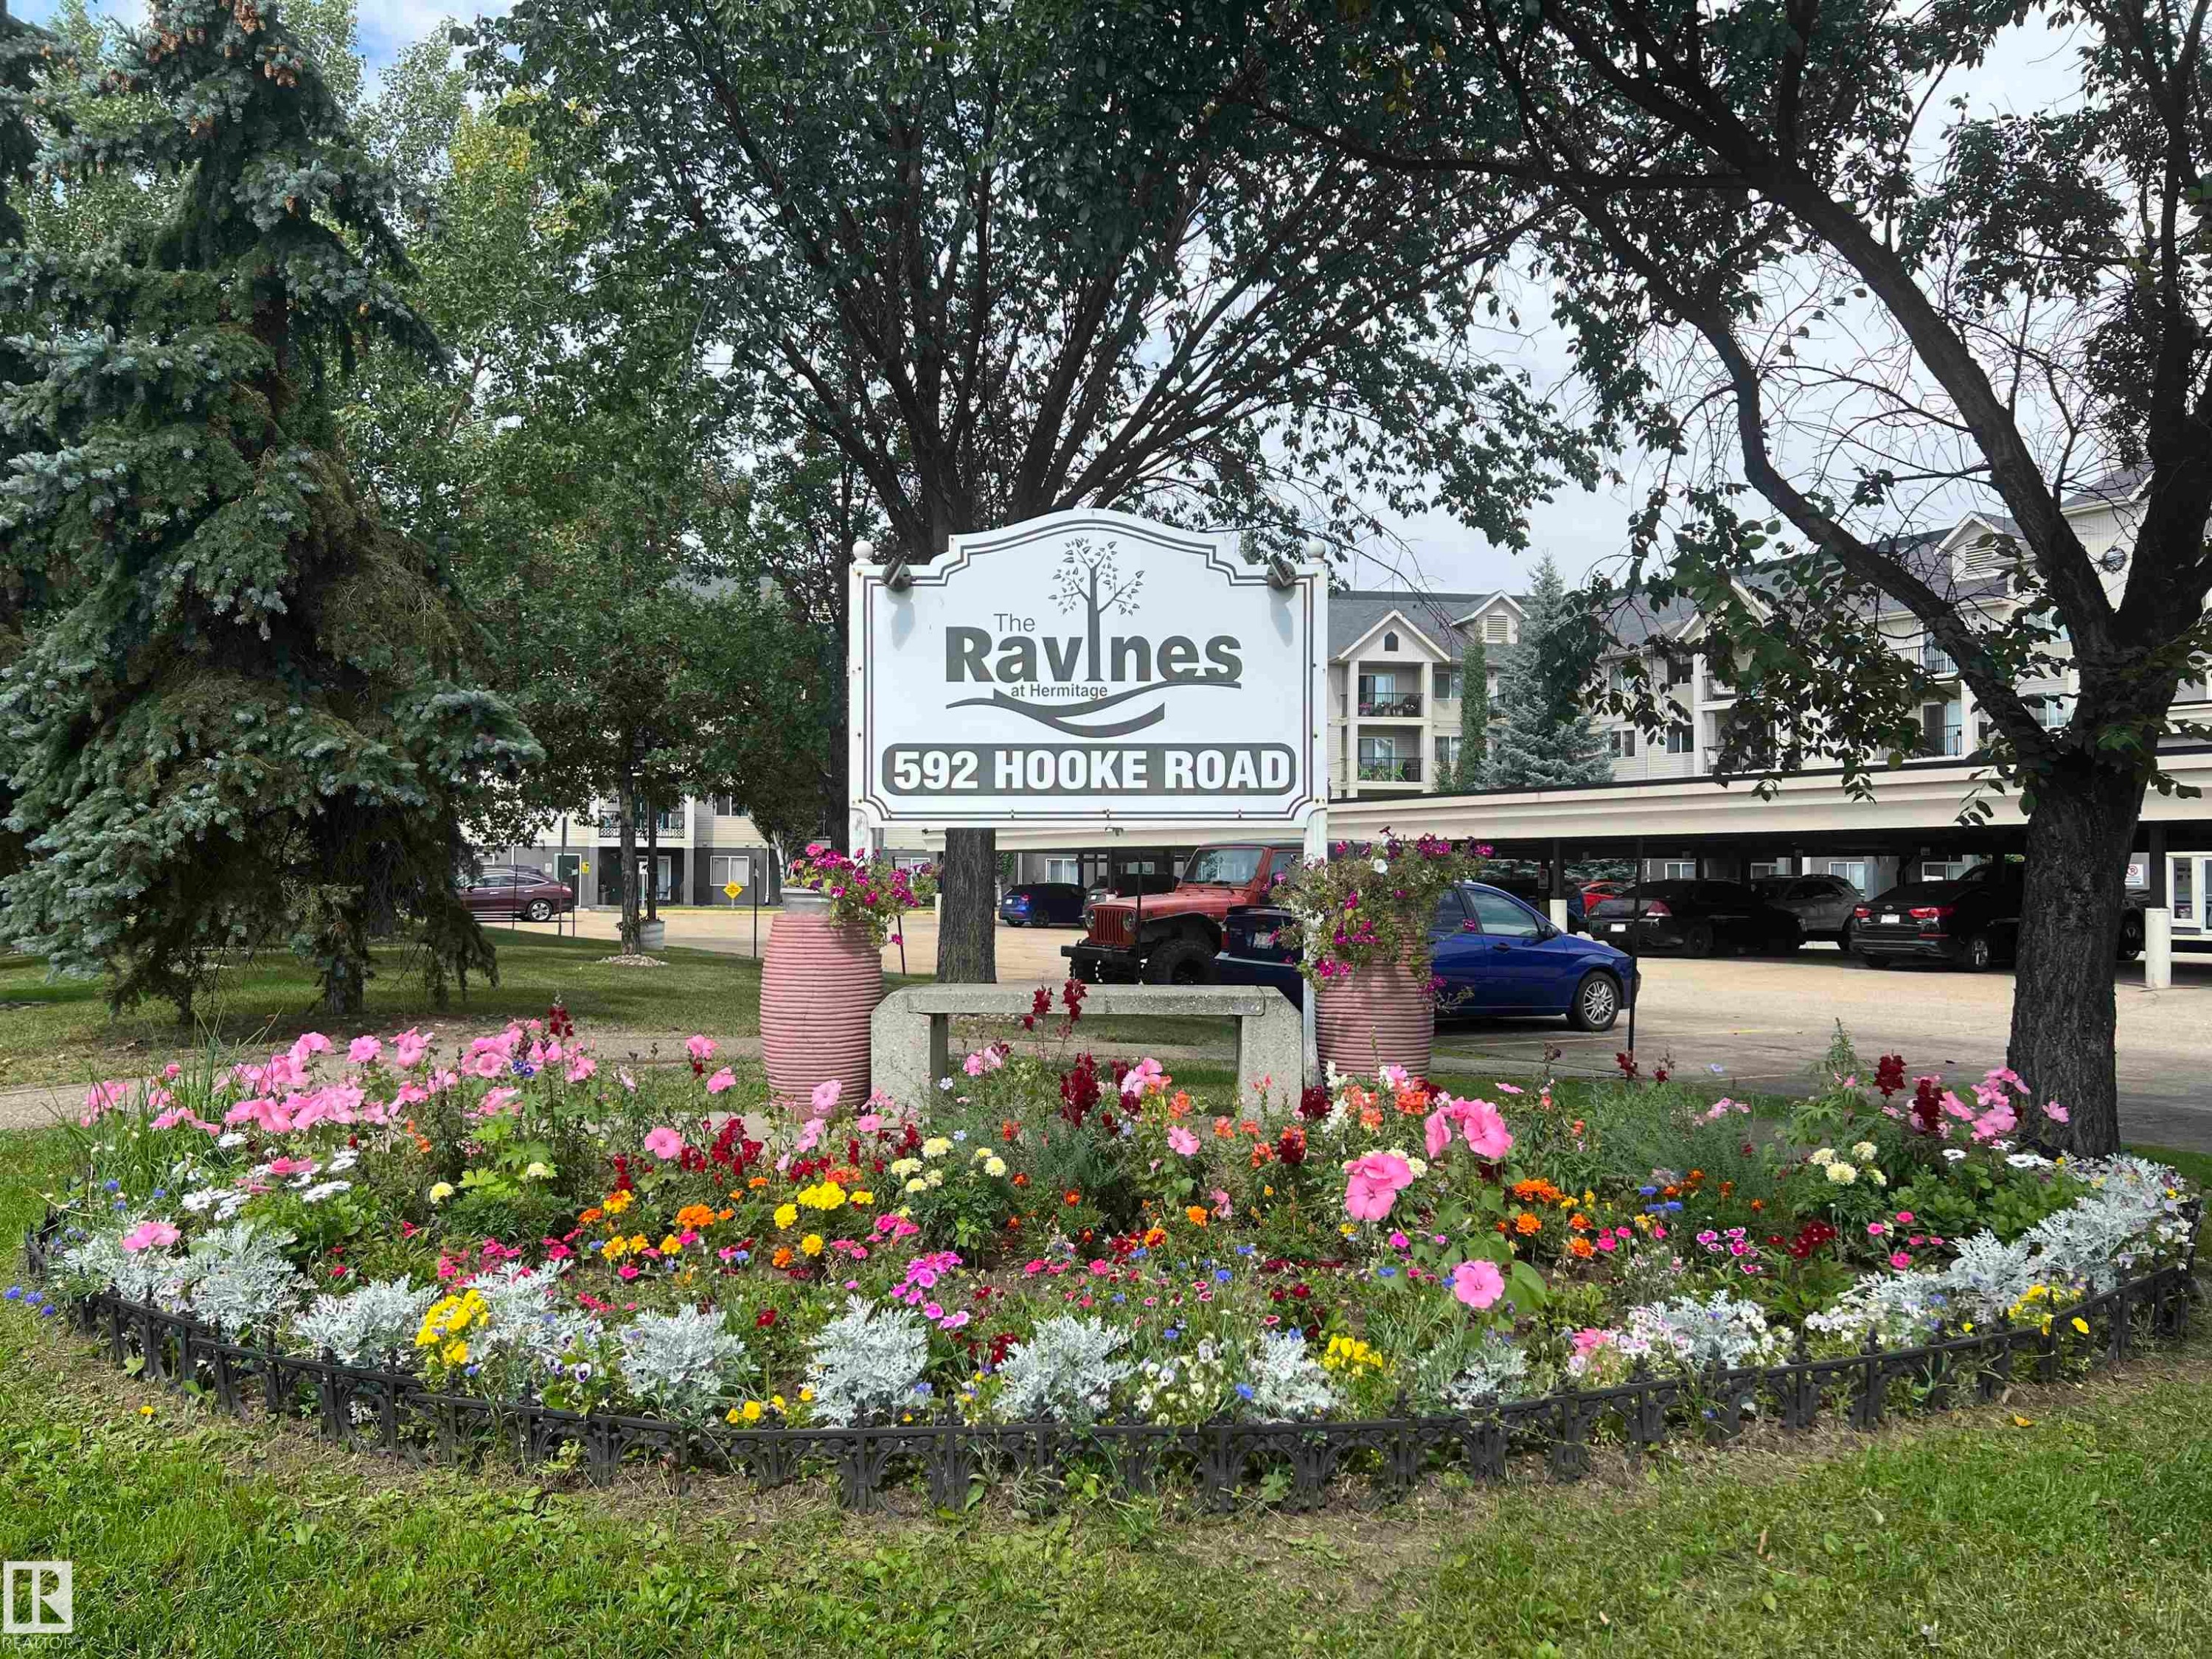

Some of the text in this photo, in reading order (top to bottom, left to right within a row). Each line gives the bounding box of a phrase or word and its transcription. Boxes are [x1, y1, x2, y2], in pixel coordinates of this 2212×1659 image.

[993, 613, 1036, 633] The
[945, 626, 1243, 683] Ravines
[1011, 684, 1108, 700] at Hermitage
[893, 750, 1291, 790] 592 HOOKE ROAD
